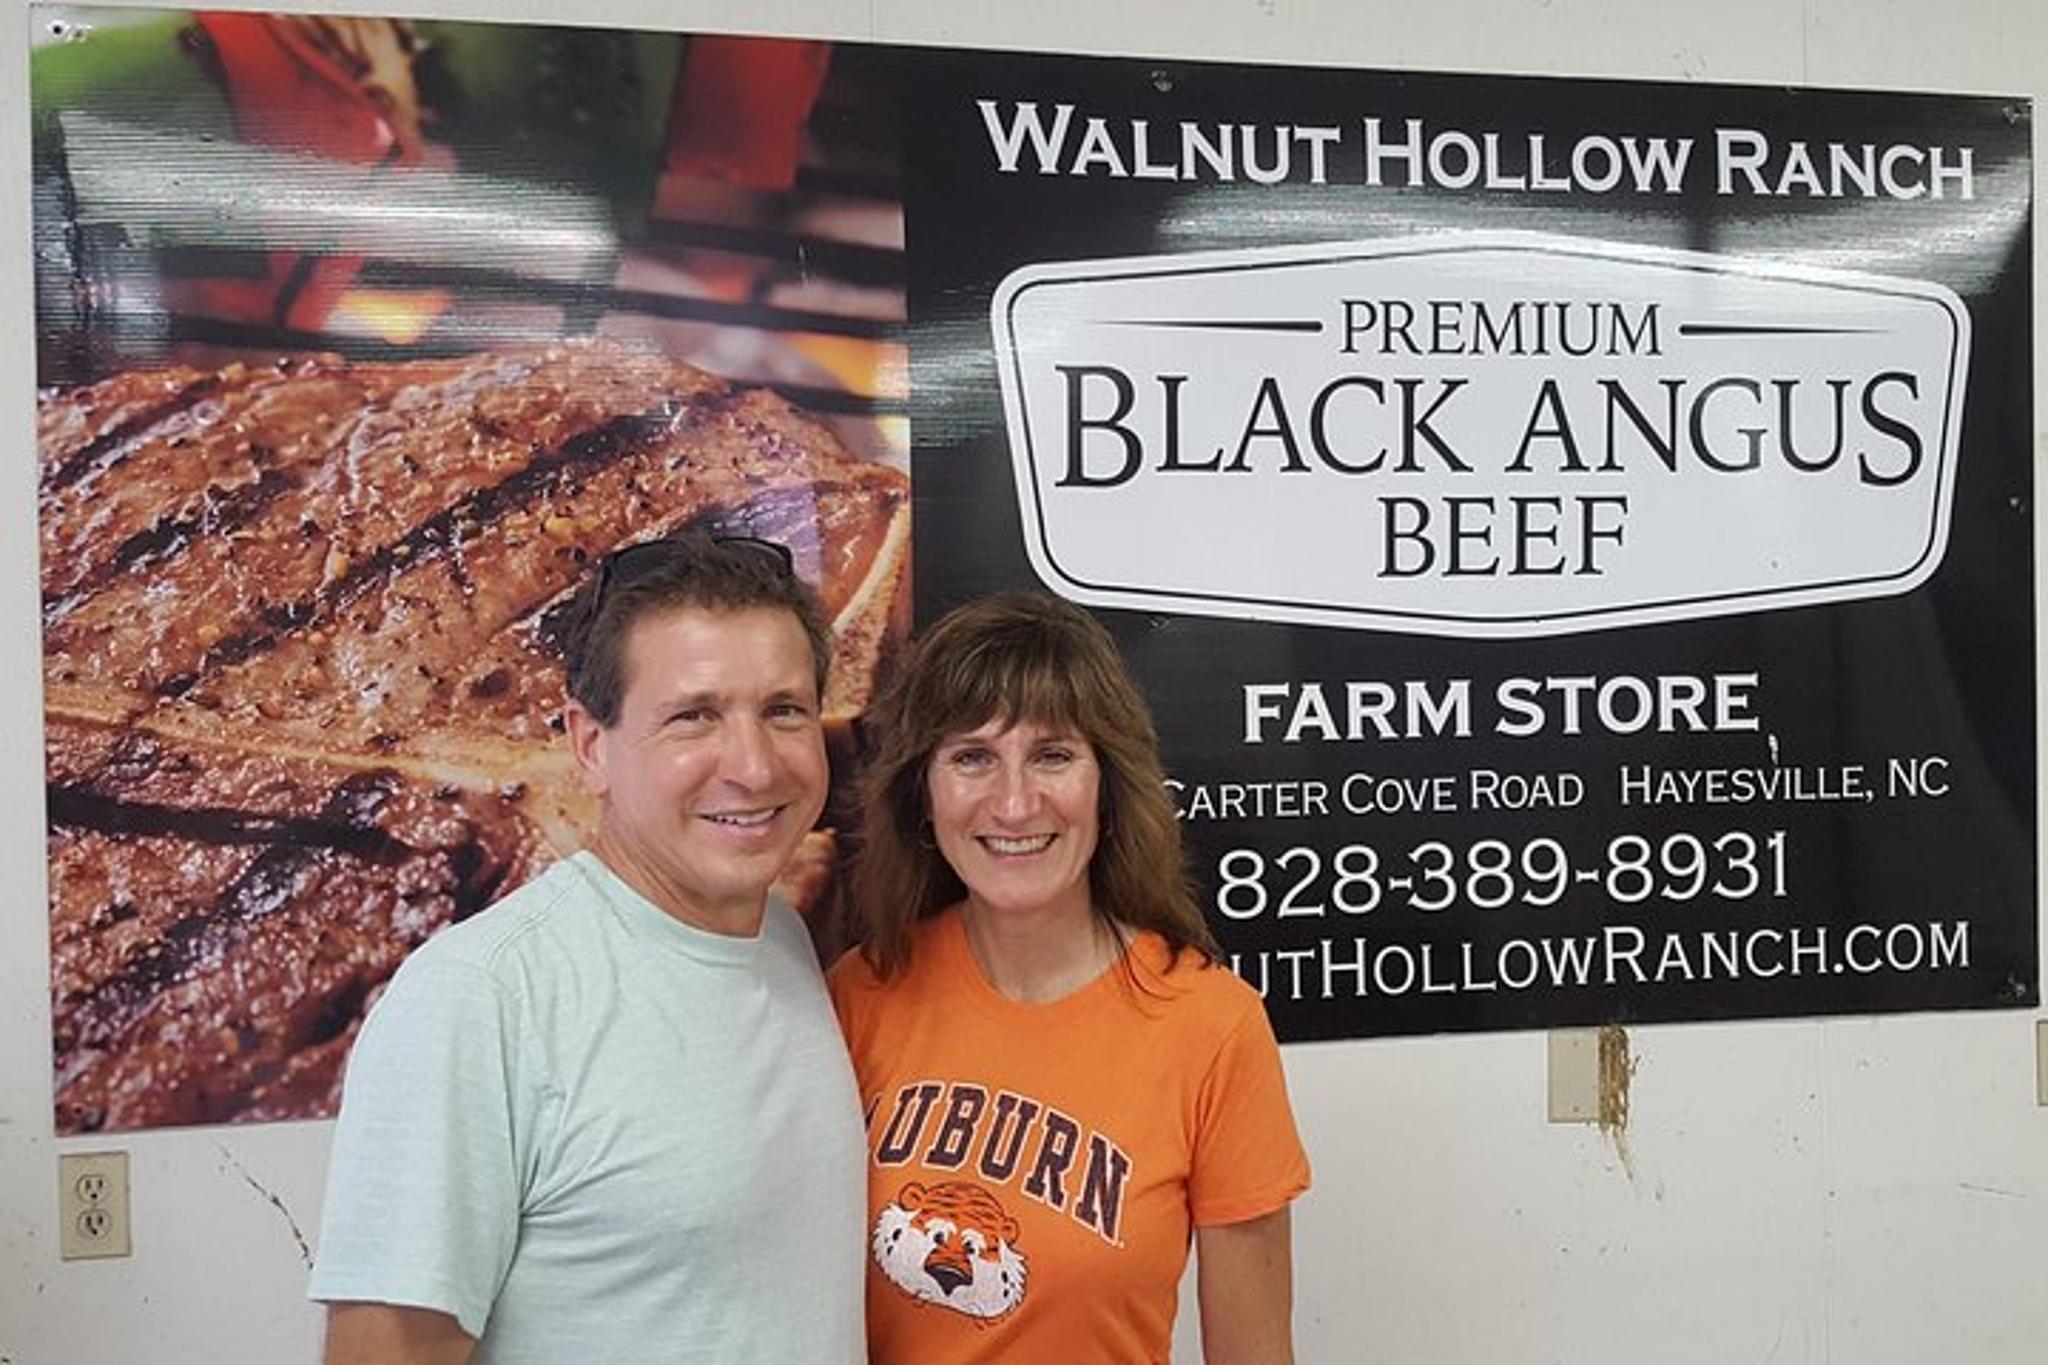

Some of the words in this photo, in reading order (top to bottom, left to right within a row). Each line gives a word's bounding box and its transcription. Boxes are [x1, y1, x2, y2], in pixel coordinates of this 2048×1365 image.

[978, 99, 1341, 184] WALNUT
[1364, 118, 1694, 194] HOLLOW
[1715, 128, 1975, 200] RANCH
[1339, 300, 1662, 357] PREMIUM
[1055, 364, 1473, 488] BLACK
[1504, 373, 1924, 487] ANGUS
[1377, 496, 1629, 578] BEEF
[1243, 680, 1472, 743] FARM
[1494, 673, 1760, 735] STORE
[1341, 775, 1456, 811] COVE
[1469, 769, 1584, 809] ROAD
[1619, 762, 1874, 806] HAYESVILLE,
[1887, 757, 1950, 797] NC
[1216, 831, 1788, 920] 828-389-8931
[866, 1080, 1133, 1248] UBURN
